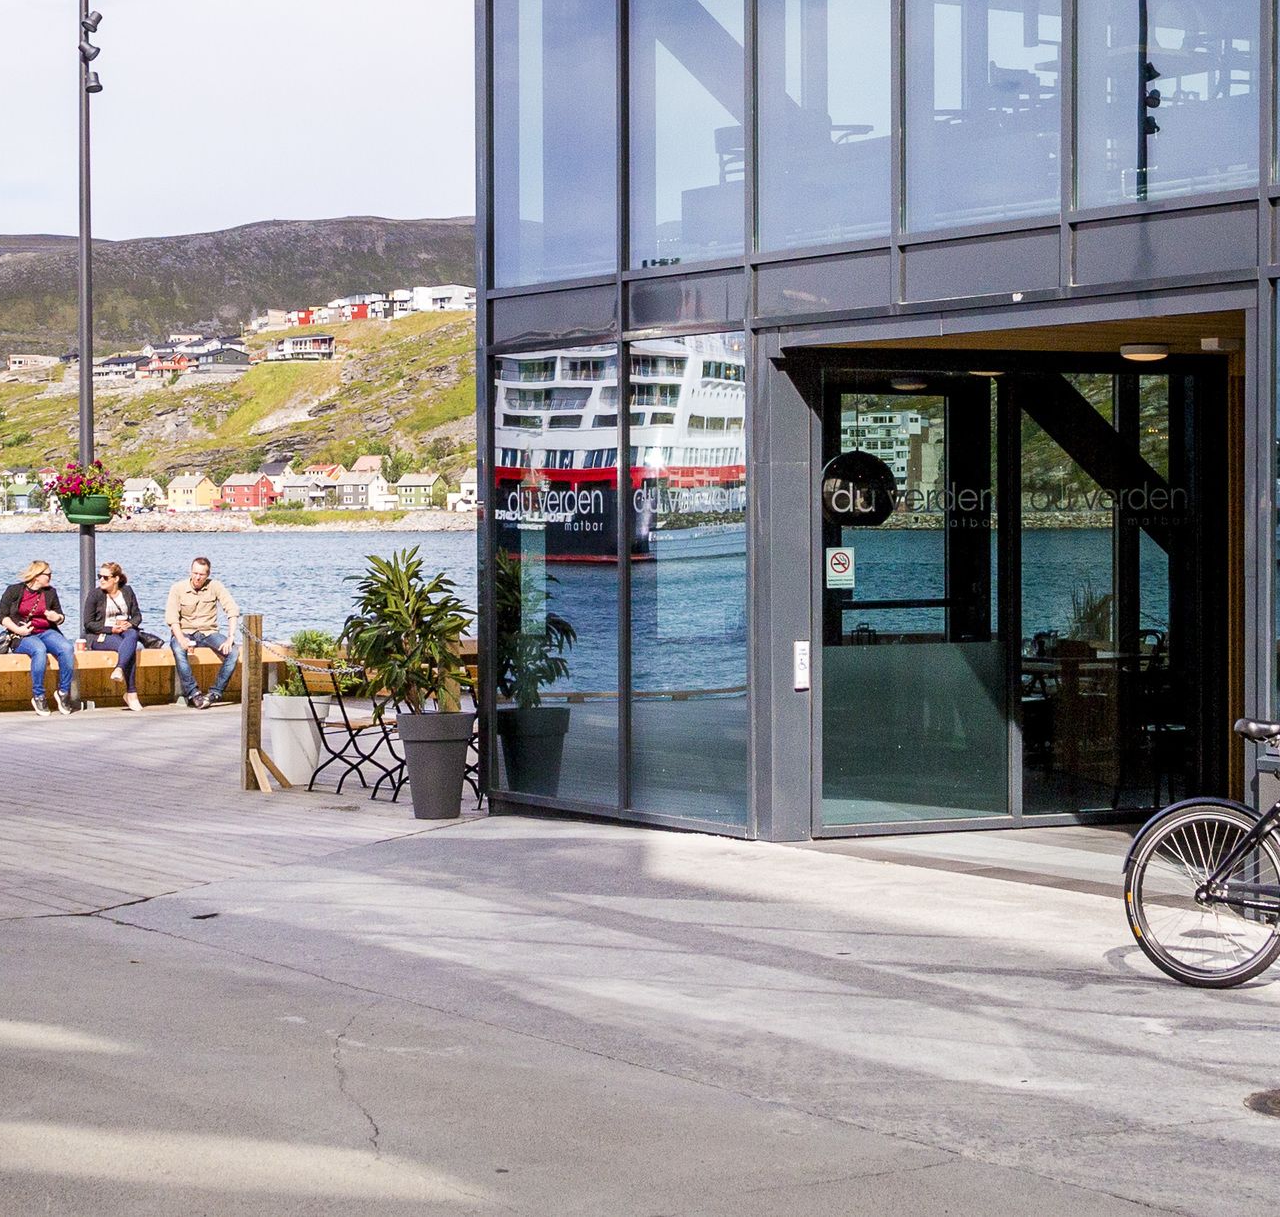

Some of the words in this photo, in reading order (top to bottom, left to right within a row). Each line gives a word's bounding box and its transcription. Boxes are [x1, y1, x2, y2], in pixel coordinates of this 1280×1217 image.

[508, 484, 532, 514] du
[537, 483, 603, 514] verden
[831, 482, 876, 513] du
[1084, 481, 1188, 511] verden
[564, 520, 603, 531] matbar
